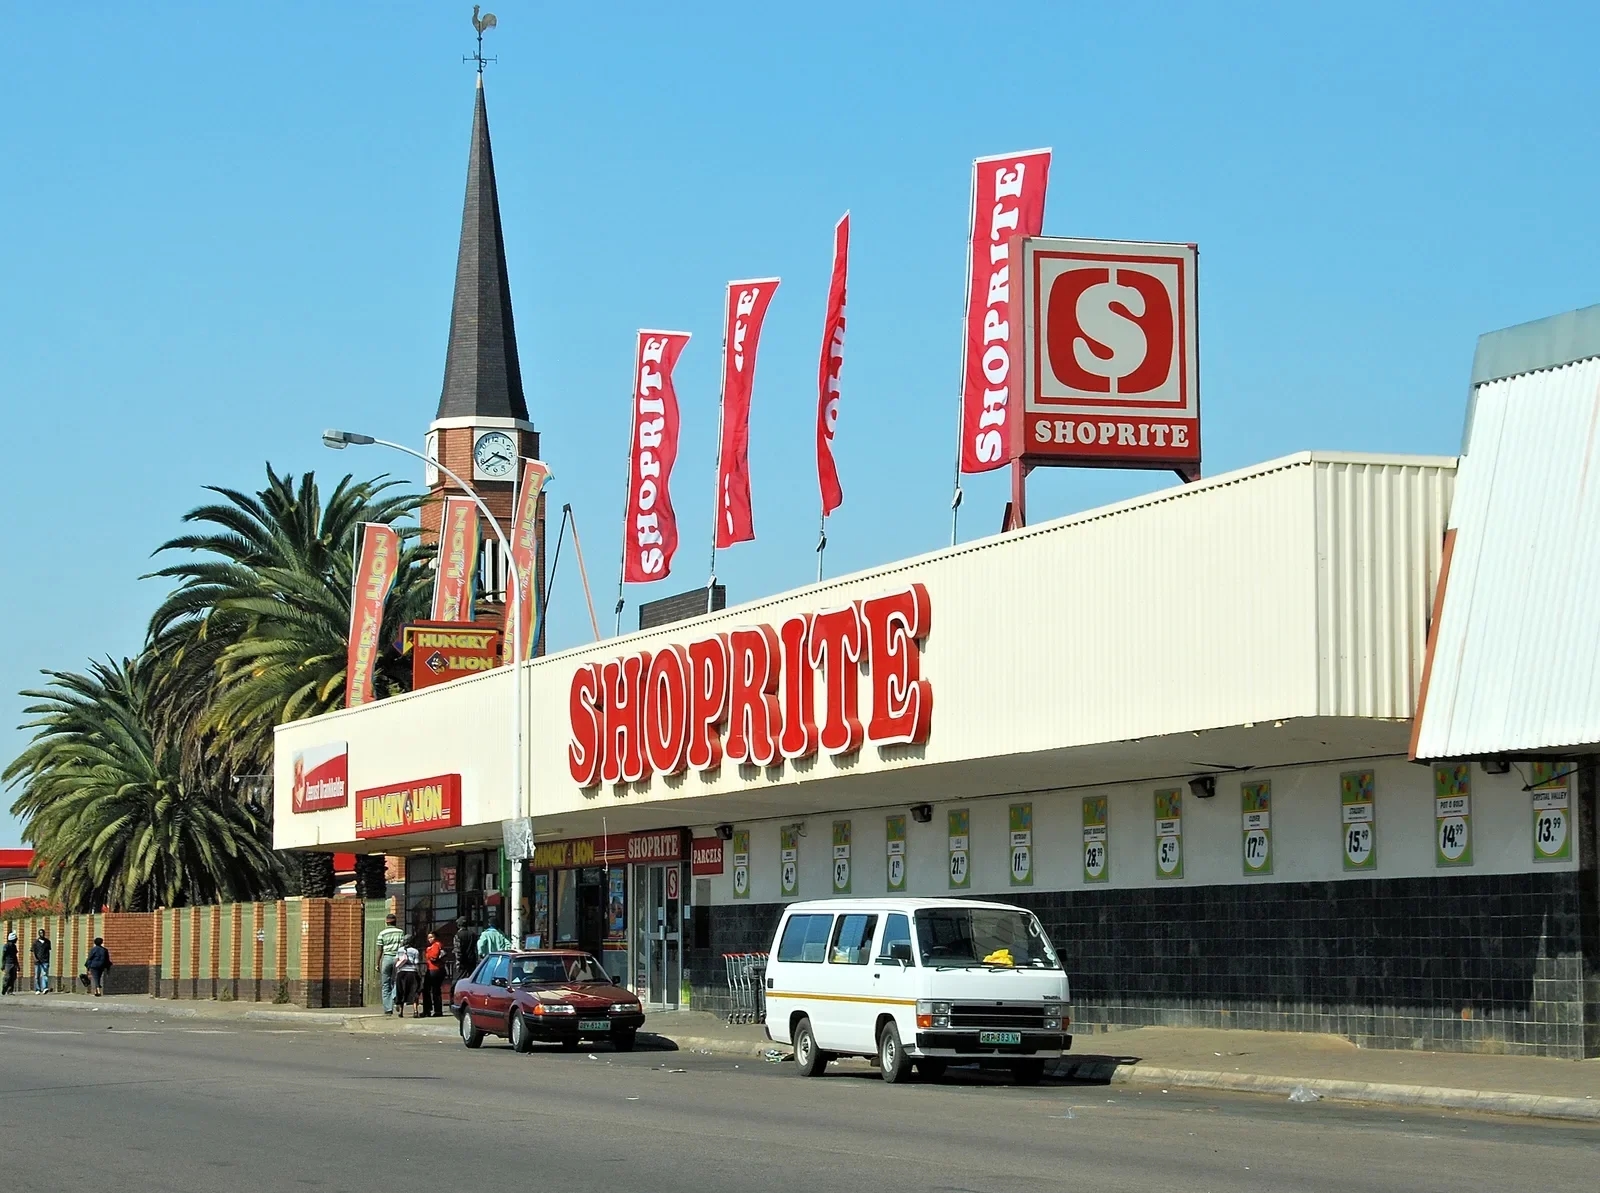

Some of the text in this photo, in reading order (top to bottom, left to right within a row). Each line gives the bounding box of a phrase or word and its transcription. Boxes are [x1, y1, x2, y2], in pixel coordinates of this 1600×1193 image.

[976, 162, 1025, 463] SHOPRITE
[636, 337, 668, 574] SHOPRITE
[1035, 420, 1189, 448] SHOPRITE
[520, 471, 540, 549] LION
[447, 506, 468, 579] LION
[365, 533, 388, 601] LION
[418, 633, 494, 649] HUNGRY
[449, 655, 494, 671] LION
[568, 583, 932, 788] SHOPRITE
[362, 784, 443, 831] HUNGRY LION
[573, 840, 594, 865] LION
[628, 835, 679, 859] SHOPRITE
[693, 848, 722, 864] PARCELS
